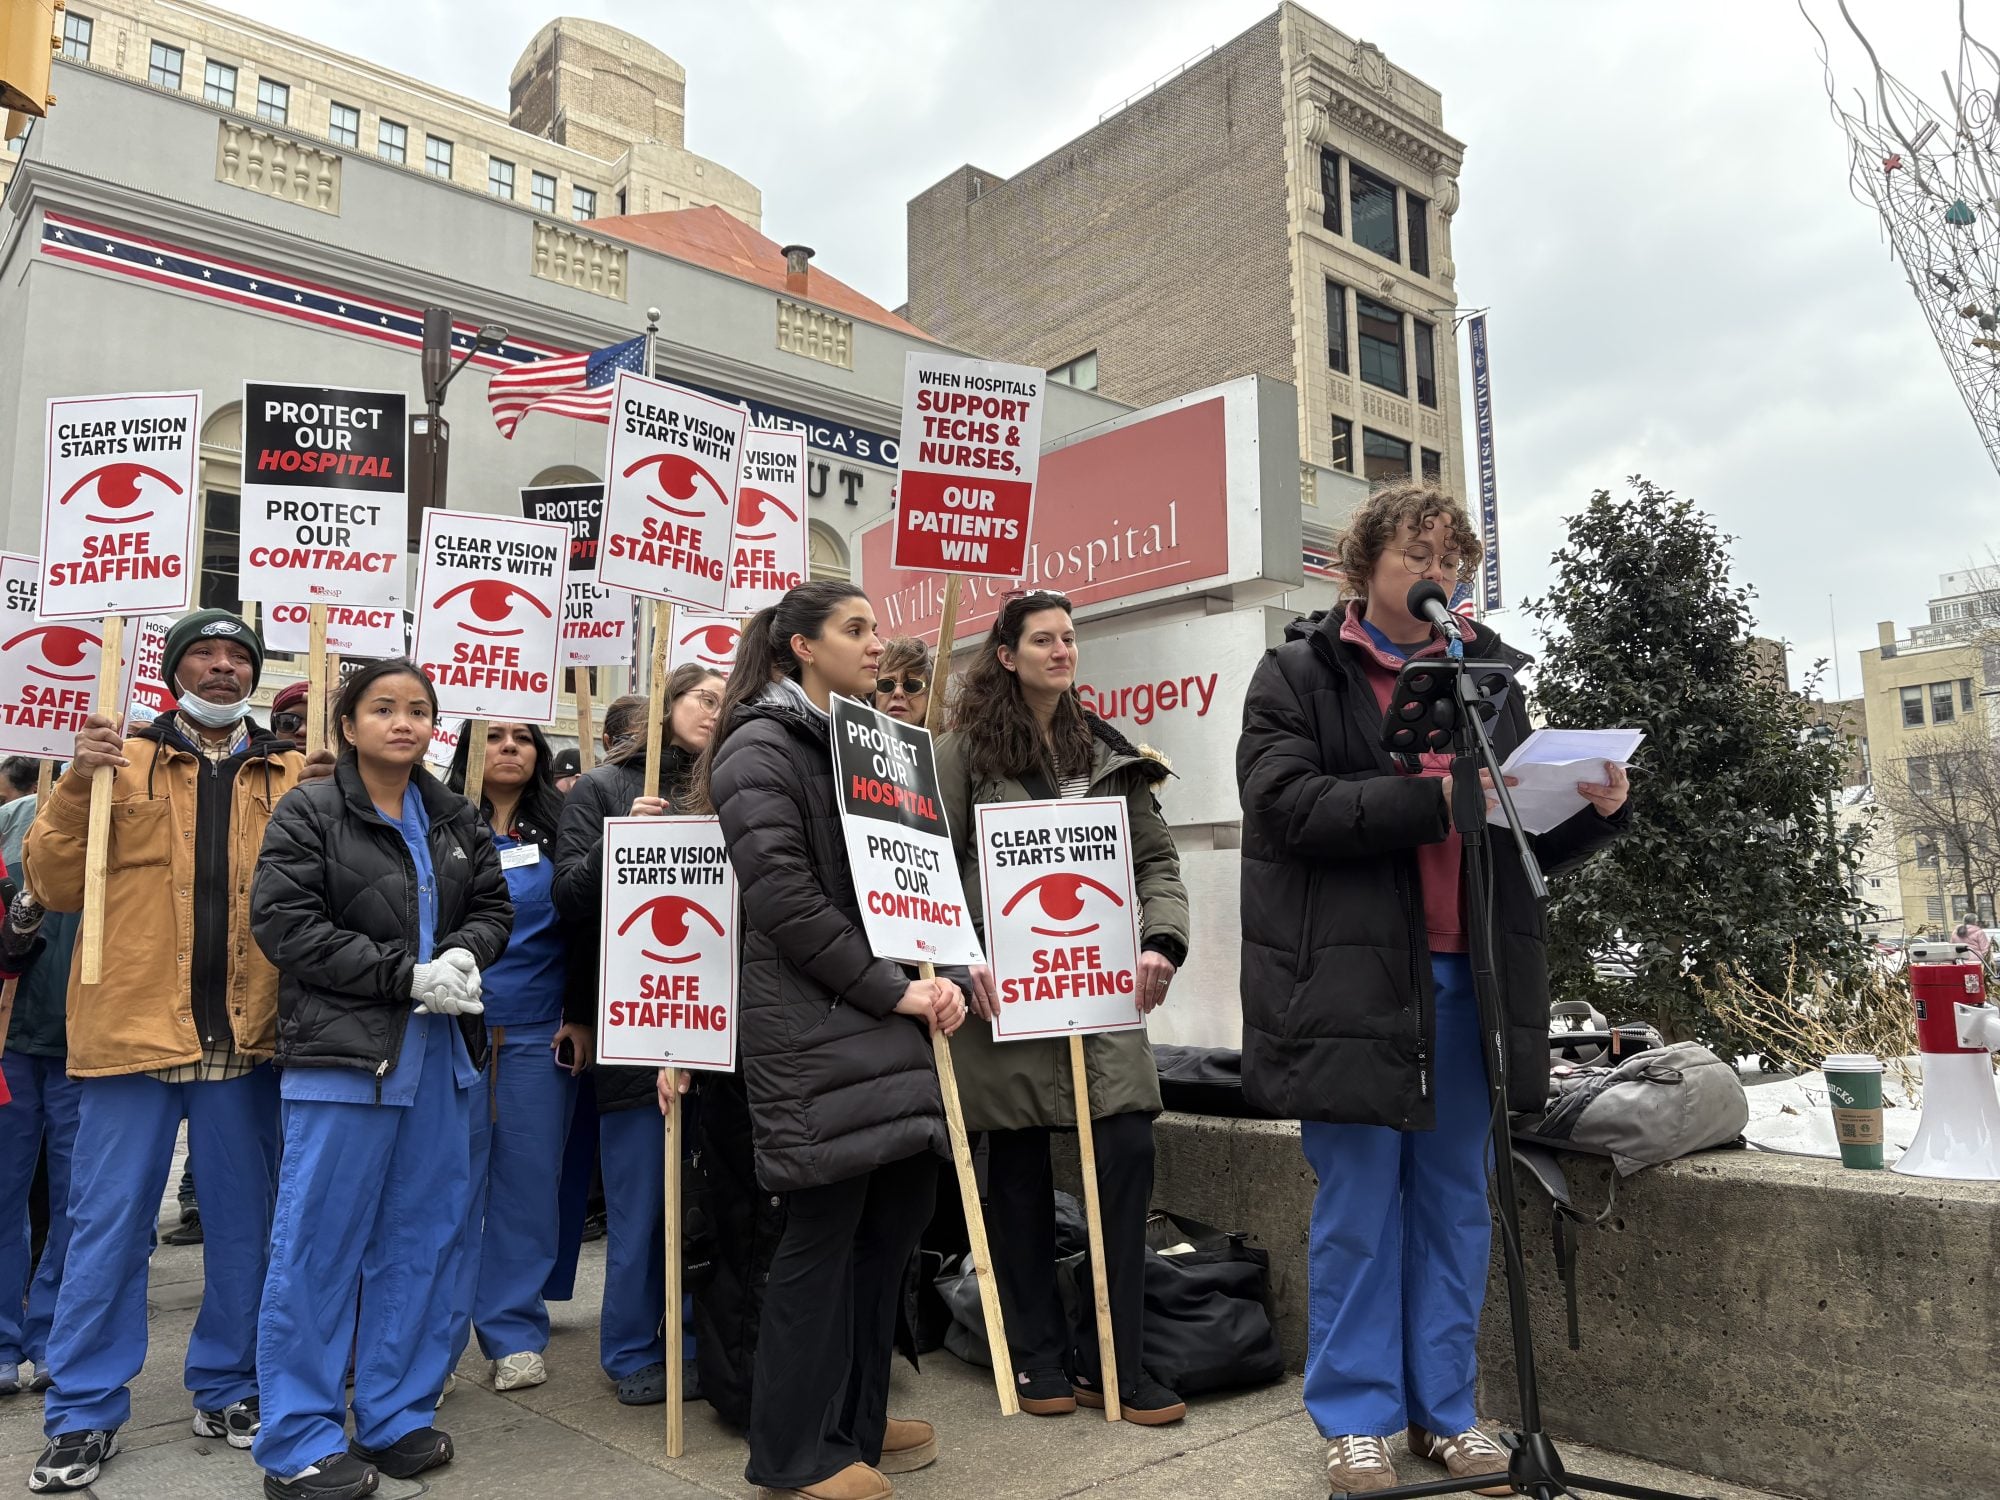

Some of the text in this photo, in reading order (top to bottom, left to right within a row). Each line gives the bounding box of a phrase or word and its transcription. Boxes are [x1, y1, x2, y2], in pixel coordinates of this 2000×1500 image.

[918, 370, 1037, 397] WHEN HOSPITALS
[265, 401, 383, 430] PROTECT
[916, 389, 1030, 422] SUPPORT
[58, 417, 187, 440] CLEAR VISION
[624, 399, 736, 446] CLEAR VISION
[923, 416, 1020, 447] TECHS &
[60, 435, 182, 458] STARTS WITH
[295, 426, 352, 451] OUR
[625, 418, 731, 462] STARTS WITH
[257, 450, 393, 478] HOSPITAL
[746, 450, 797, 468] VISION
[918, 441, 1022, 475] NURSES,
[756, 467, 795, 483] WITH
[535, 499, 604, 521] PROTEC
[943, 486, 996, 511] OUR
[266, 500, 380, 526] PROTECT
[908, 509, 1019, 540] PATIENTS
[296, 525, 351, 547] OUR
[570, 521, 590, 538] UR
[641, 516, 703, 551] SAFE
[82, 531, 150, 559] SAFE
[434, 534, 492, 554] CLEAR
[496, 540, 557, 561] VISION
[608, 534, 724, 582] STAFFING
[733, 549, 776, 569] AFE
[941, 539, 989, 564] WIN
[49, 554, 182, 586] STAFFING
[249, 546, 397, 573] CONTRACT
[436, 552, 553, 577] STARTS WITH
[884, 499, 1180, 629] Wills ye Hospital
[6, 579, 38, 597] CLE
[272, 604, 395, 628] COTRACT
[453, 642, 520, 668] SAFE
[420, 663, 548, 693] STAFFING
[20, 684, 91, 712] SAFE
[1076, 673, 1218, 725] Surgery
[846, 720, 917, 767] PROTECT
[872, 754, 909, 787] OUR
[852, 775, 938, 820] HOSPITAL
[991, 825, 1118, 849] CLEAR VISION
[615, 846, 727, 865] CLEAR VISION
[867, 834, 940, 873] PROTECT
[995, 844, 1116, 867] STARTS WITH
[617, 867, 724, 885] STARTS WITH
[894, 866, 930, 896] OUR
[867, 890, 962, 927] CONTRACT
[1032, 945, 1102, 974] SAFE
[639, 973, 700, 1001] SAFE
[1001, 969, 1134, 1004] STAFFING
[609, 1001, 727, 1032] STAFFING
